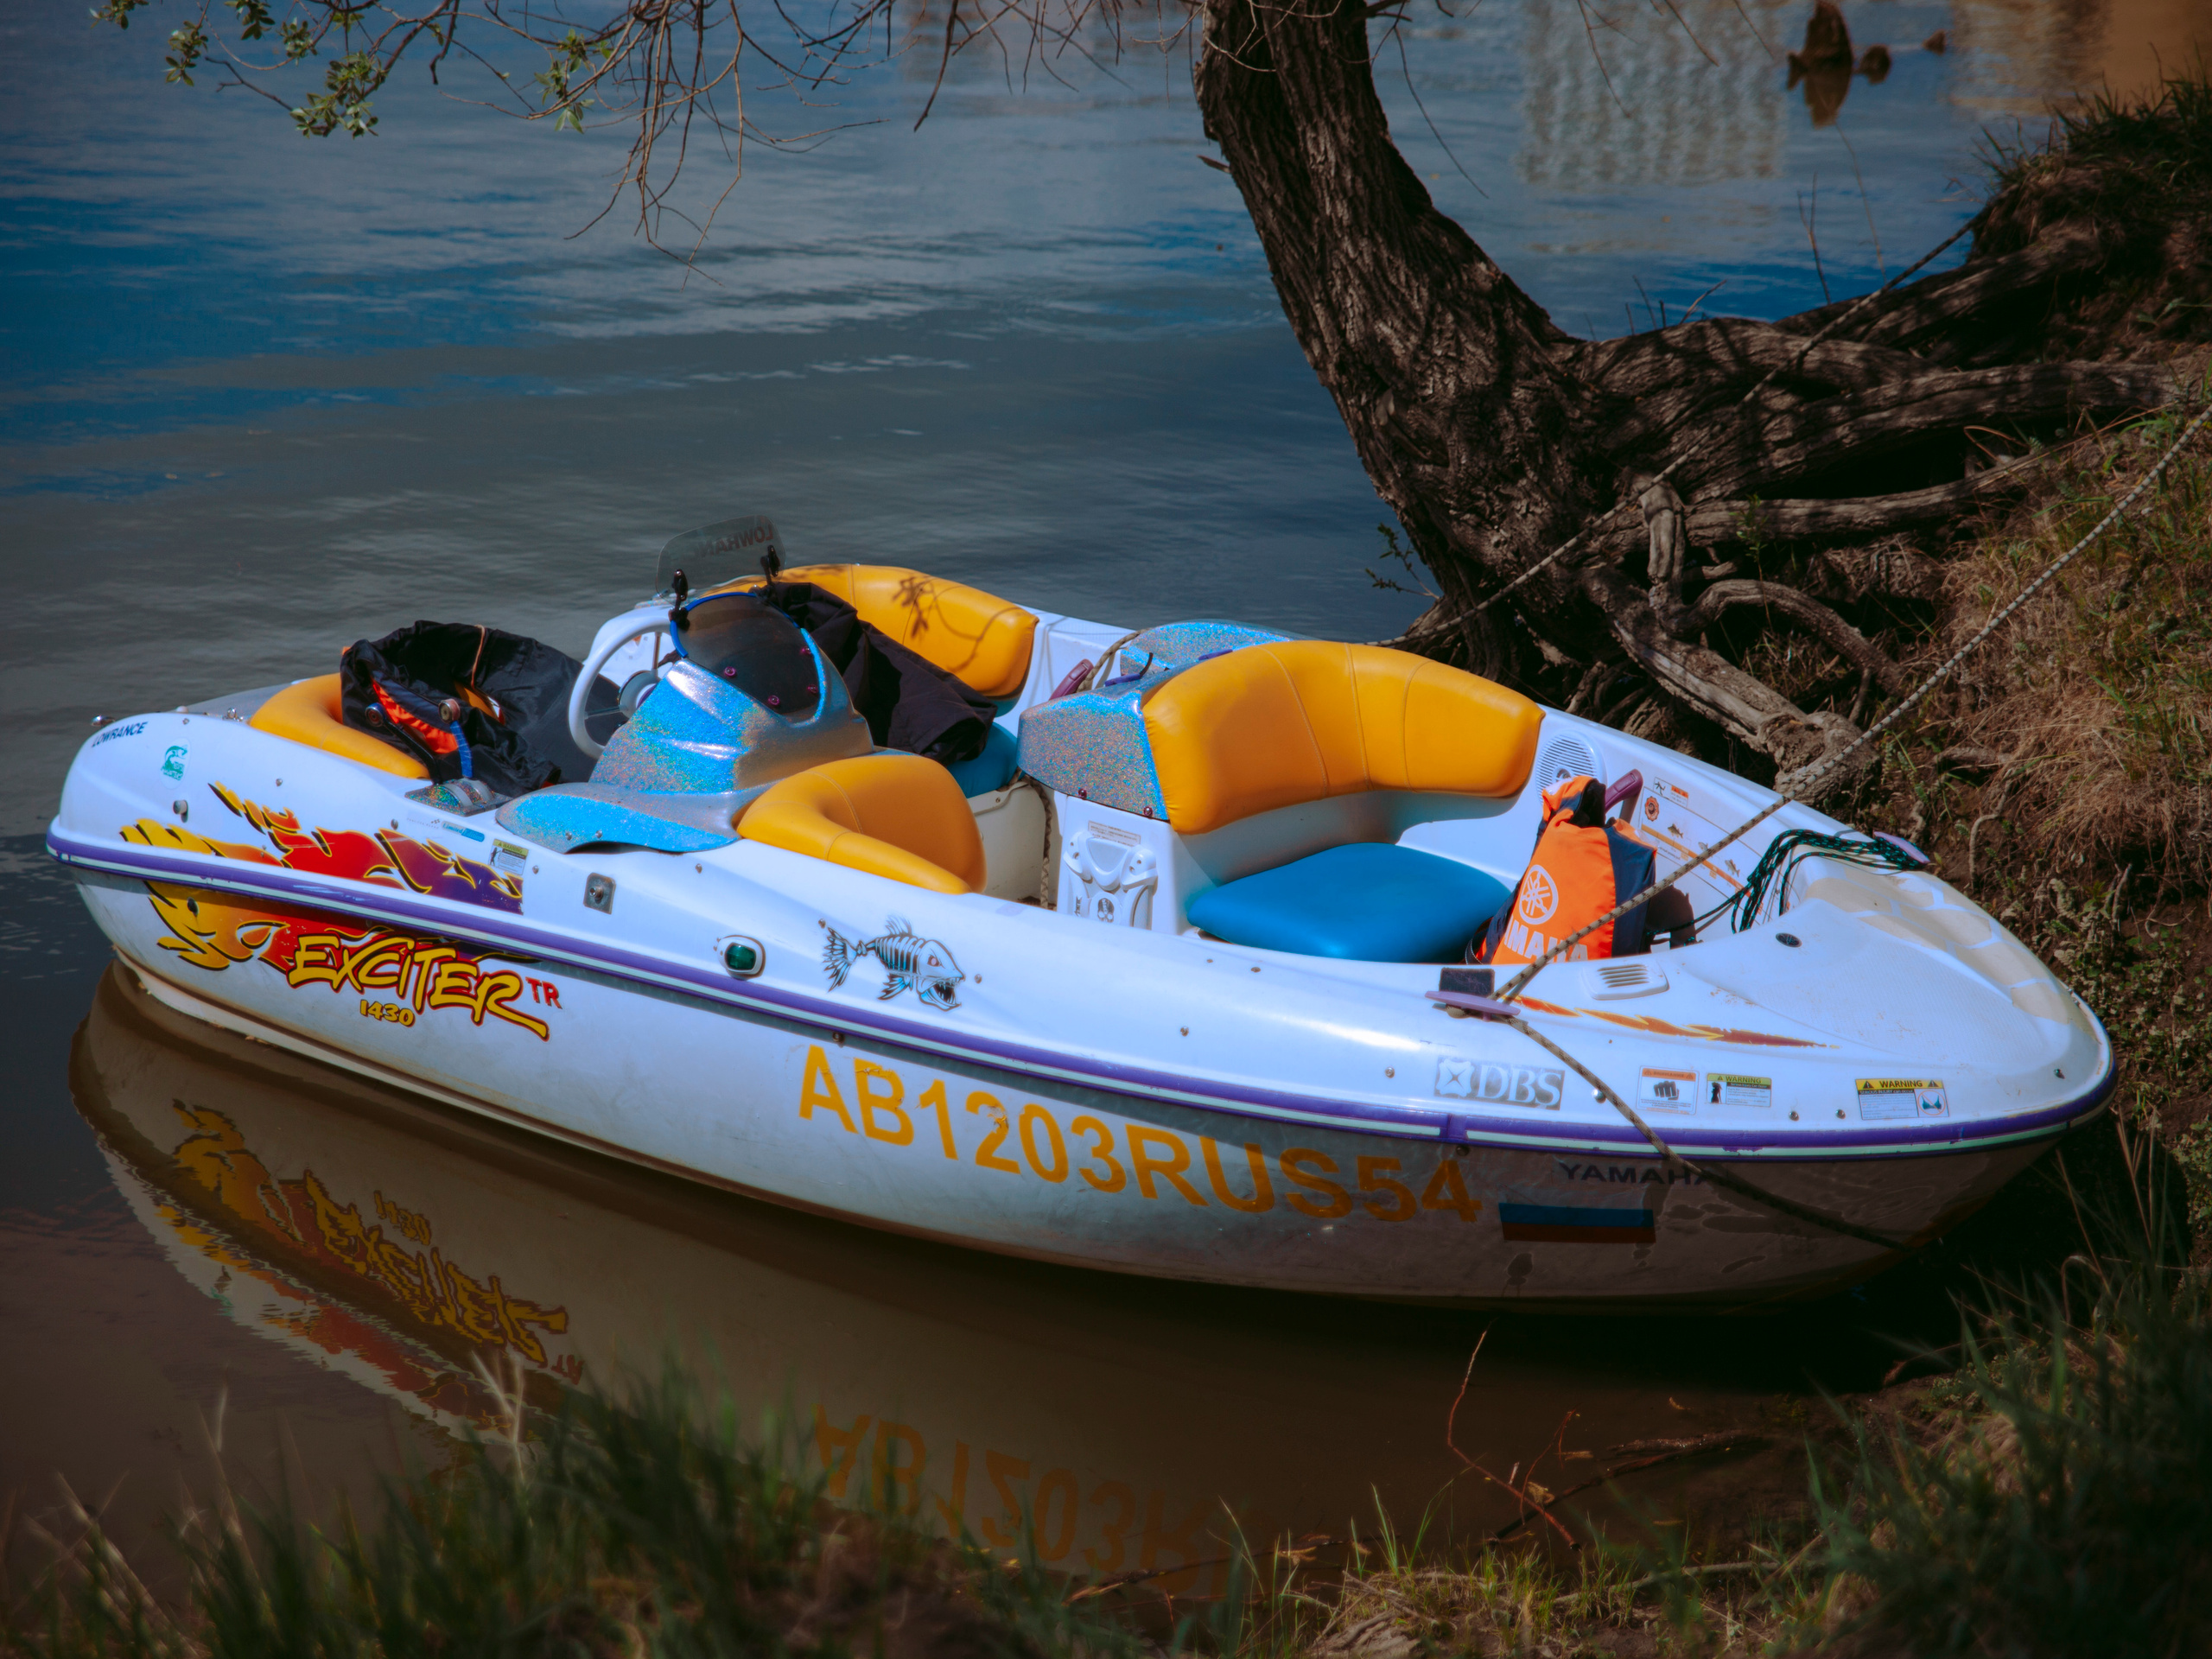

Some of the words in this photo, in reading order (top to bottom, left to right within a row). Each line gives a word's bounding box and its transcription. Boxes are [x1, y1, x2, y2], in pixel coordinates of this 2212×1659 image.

[92, 721, 148, 747] LOWRANCE
[286, 933, 550, 1042] EXCITER
[525, 976, 563, 1009] TR
[359, 998, 416, 1027] 1430
[1476, 1064, 1562, 1106] DBS
[1725, 1076, 1763, 1084] WARNING
[798, 1045, 1483, 1224] AB1203RUS54
